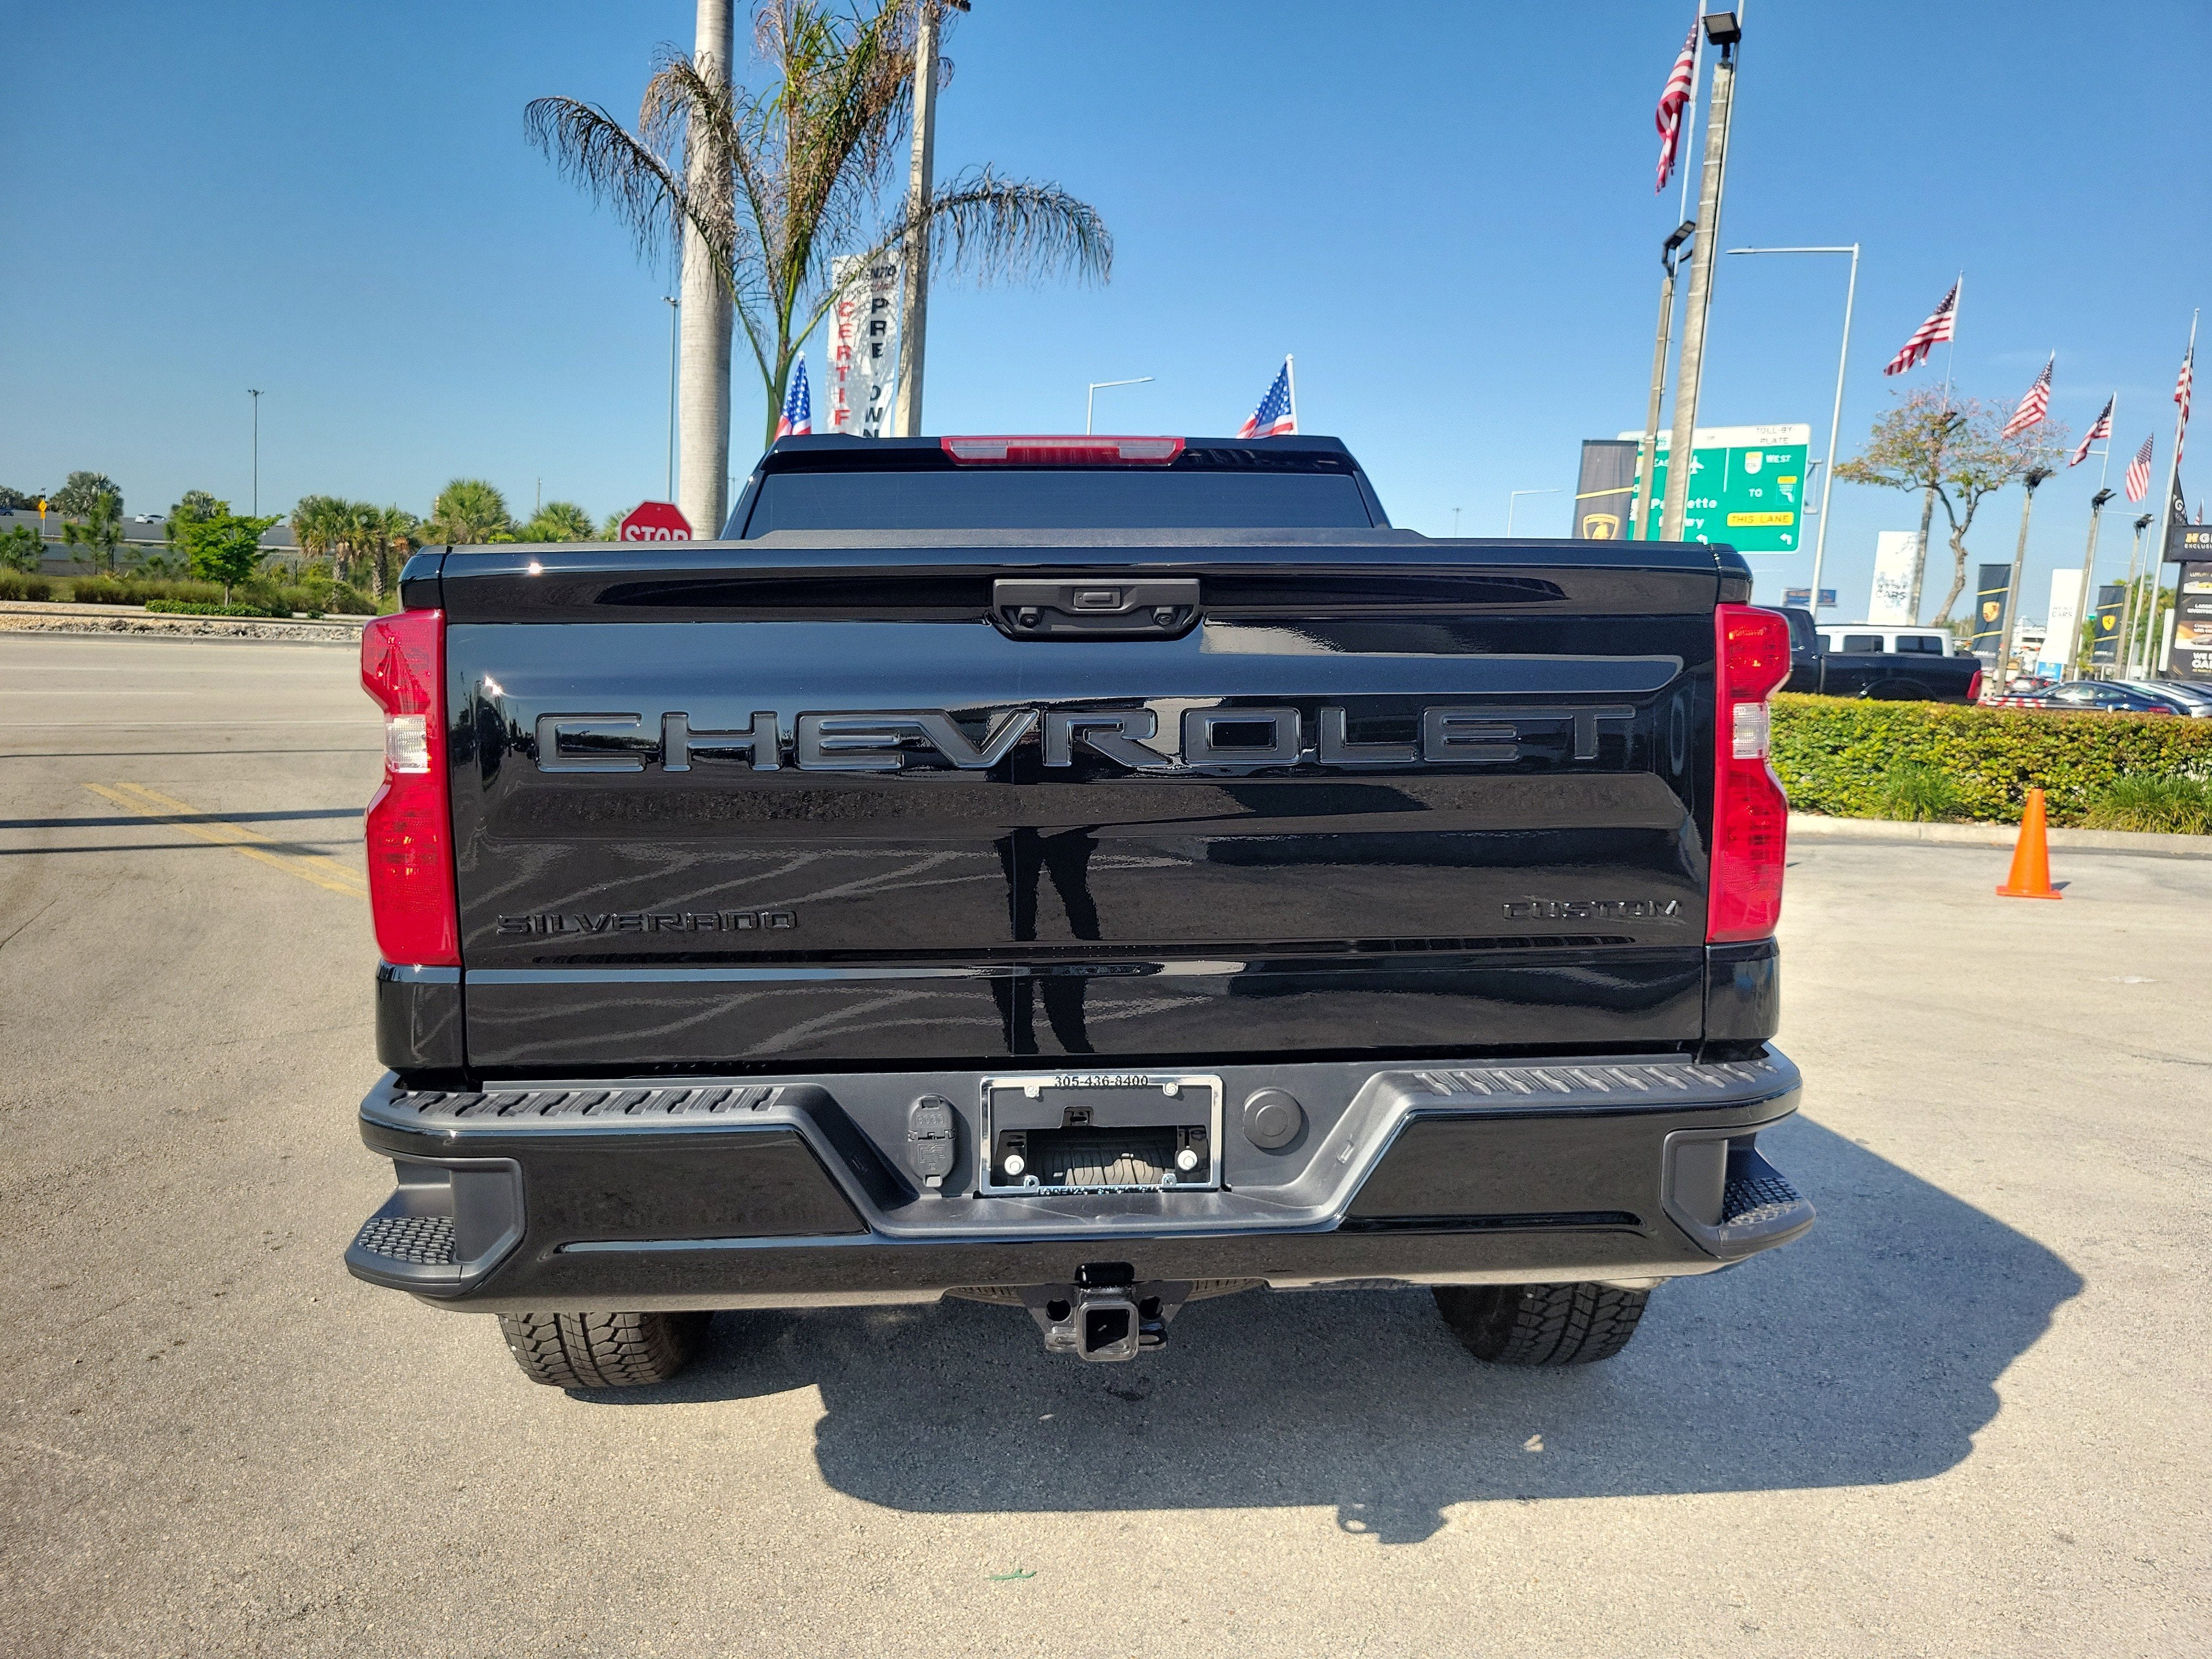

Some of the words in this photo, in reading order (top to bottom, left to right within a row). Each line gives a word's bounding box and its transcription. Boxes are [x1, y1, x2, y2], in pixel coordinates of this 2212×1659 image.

[835, 301, 855, 433] CERTIF
[1765, 454, 1792, 464] WEST
[1748, 488, 1763, 498] TO
[1731, 515, 1754, 523] THIS
[1759, 515, 1789, 523] LANE
[535, 704, 1637, 772] CHEVROLET
[1502, 900, 1683, 919] CUSTOM
[496, 911, 798, 933] SILVERADO
[1054, 1075, 1148, 1087] 305-436-8400
